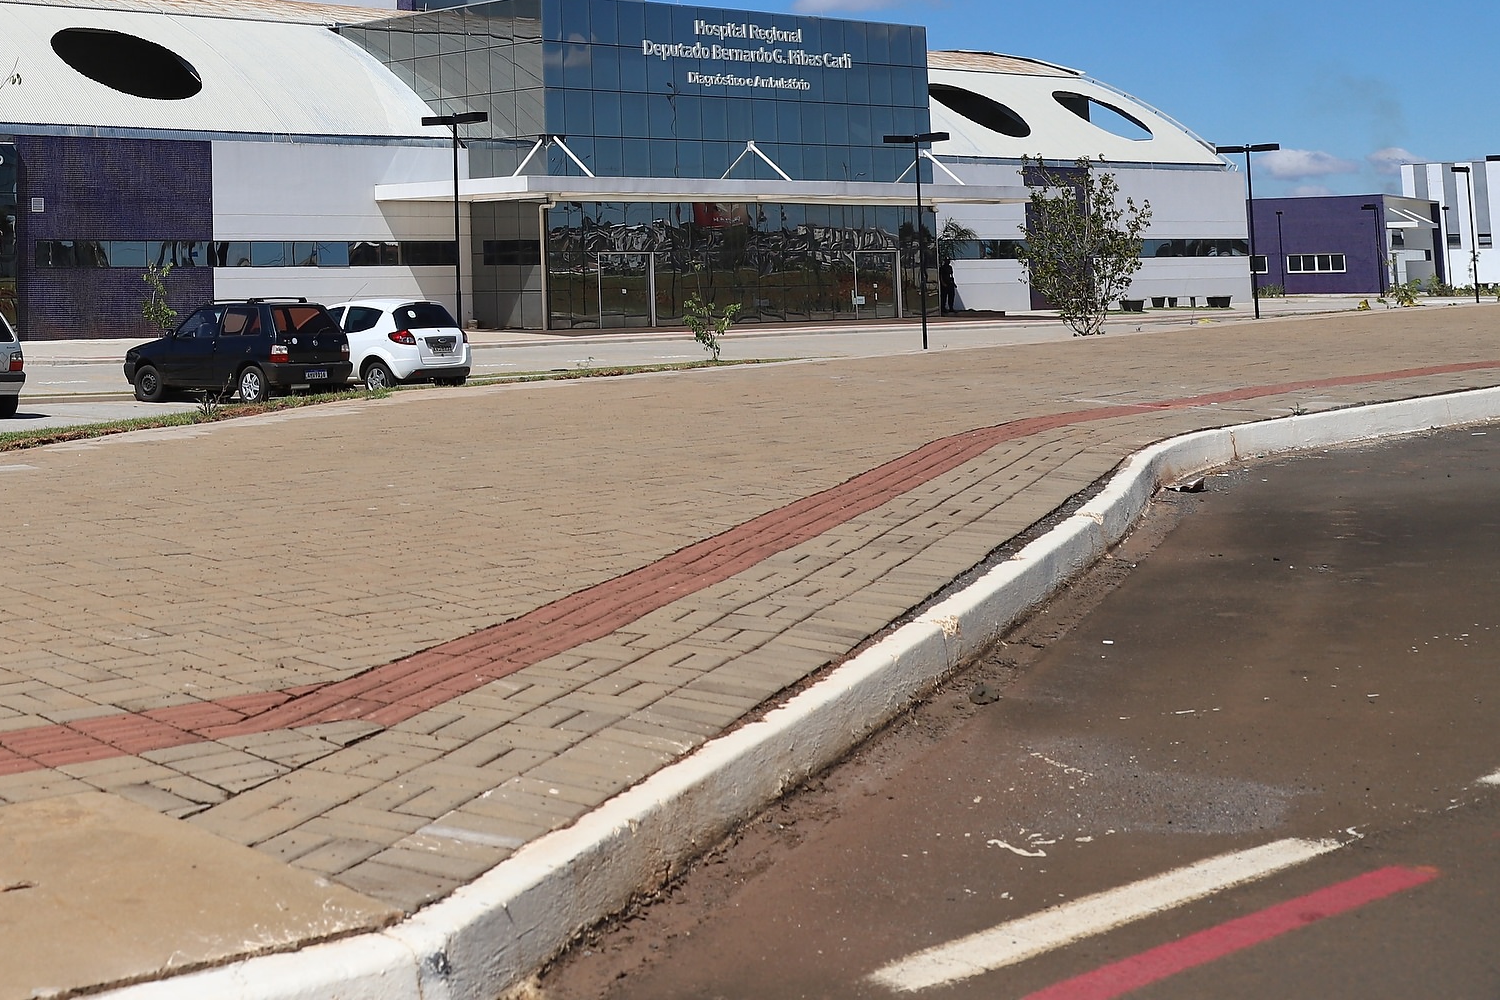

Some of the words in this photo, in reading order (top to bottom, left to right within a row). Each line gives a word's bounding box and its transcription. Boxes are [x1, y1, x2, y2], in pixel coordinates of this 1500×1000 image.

[694, 20, 747, 41] Hospital
[749, 24, 802, 44] Regional
[642, 40, 710, 61] Deputado
[711, 44, 772, 64] Bernardo
[772, 49, 787, 65] G.
[788, 49, 821, 67] Ribas
[822, 52, 852, 69] Carli
[687, 72, 745, 87] Diagnóstico
[753, 75, 810, 90] Ambulatório
